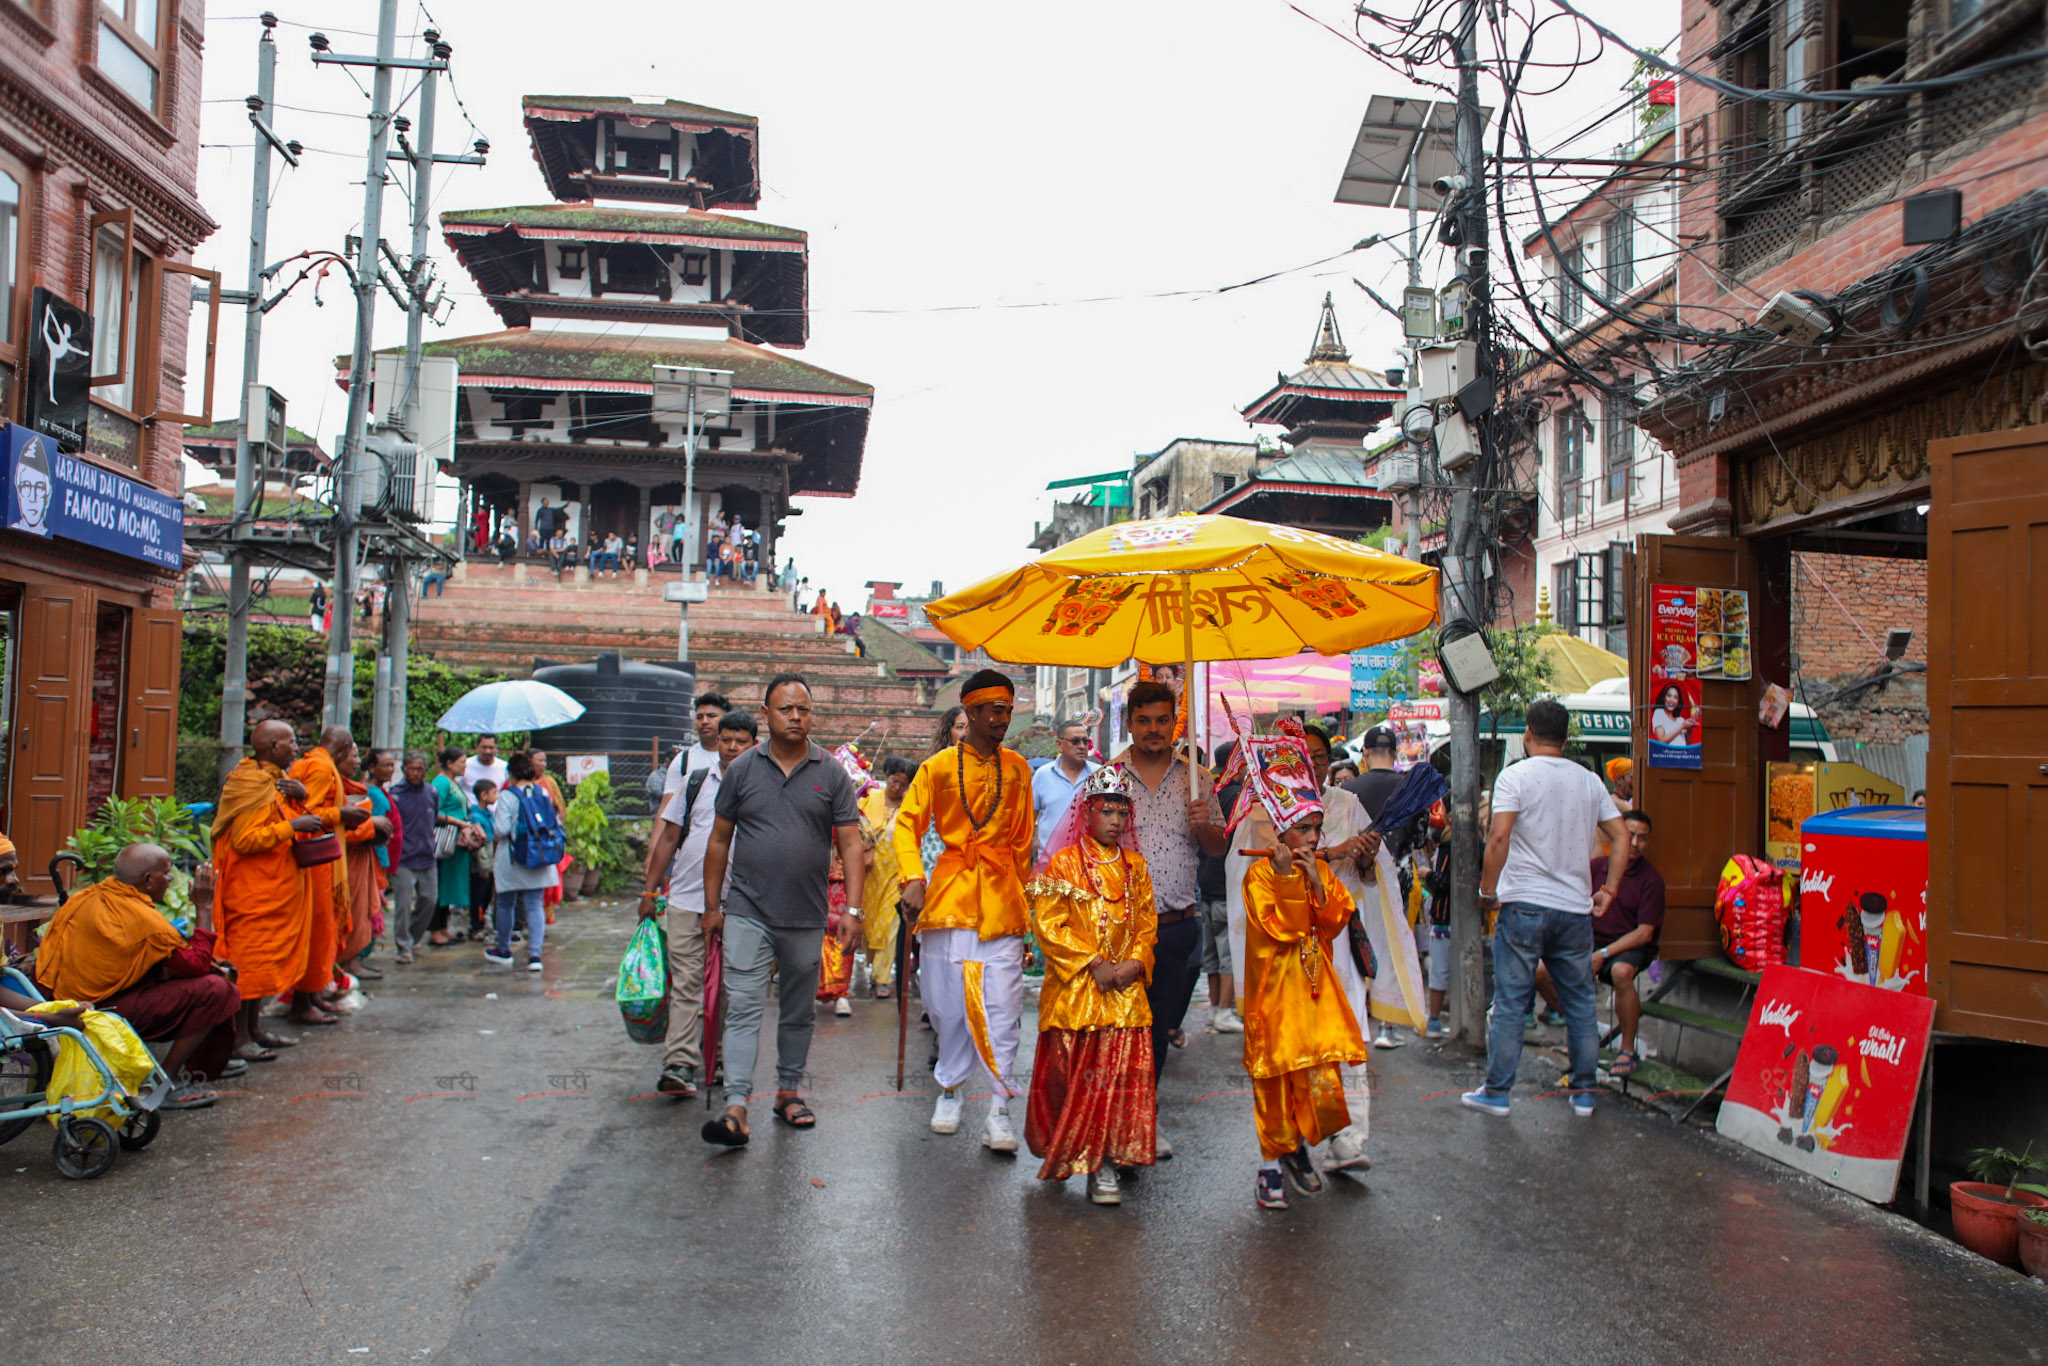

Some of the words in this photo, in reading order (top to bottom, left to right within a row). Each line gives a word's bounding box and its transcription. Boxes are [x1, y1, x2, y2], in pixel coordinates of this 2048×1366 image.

[64, 489, 116, 531] FAMOUS
[98, 473, 116, 499] DAI
[117, 482, 131, 504] KO
[172, 506, 182, 524] KO
[142, 544, 162, 562] SINCE
[1658, 603, 1697, 620] Everyday
[1656, 633, 1669, 641] ICE
[1759, 998, 1798, 1038] Vadilal
